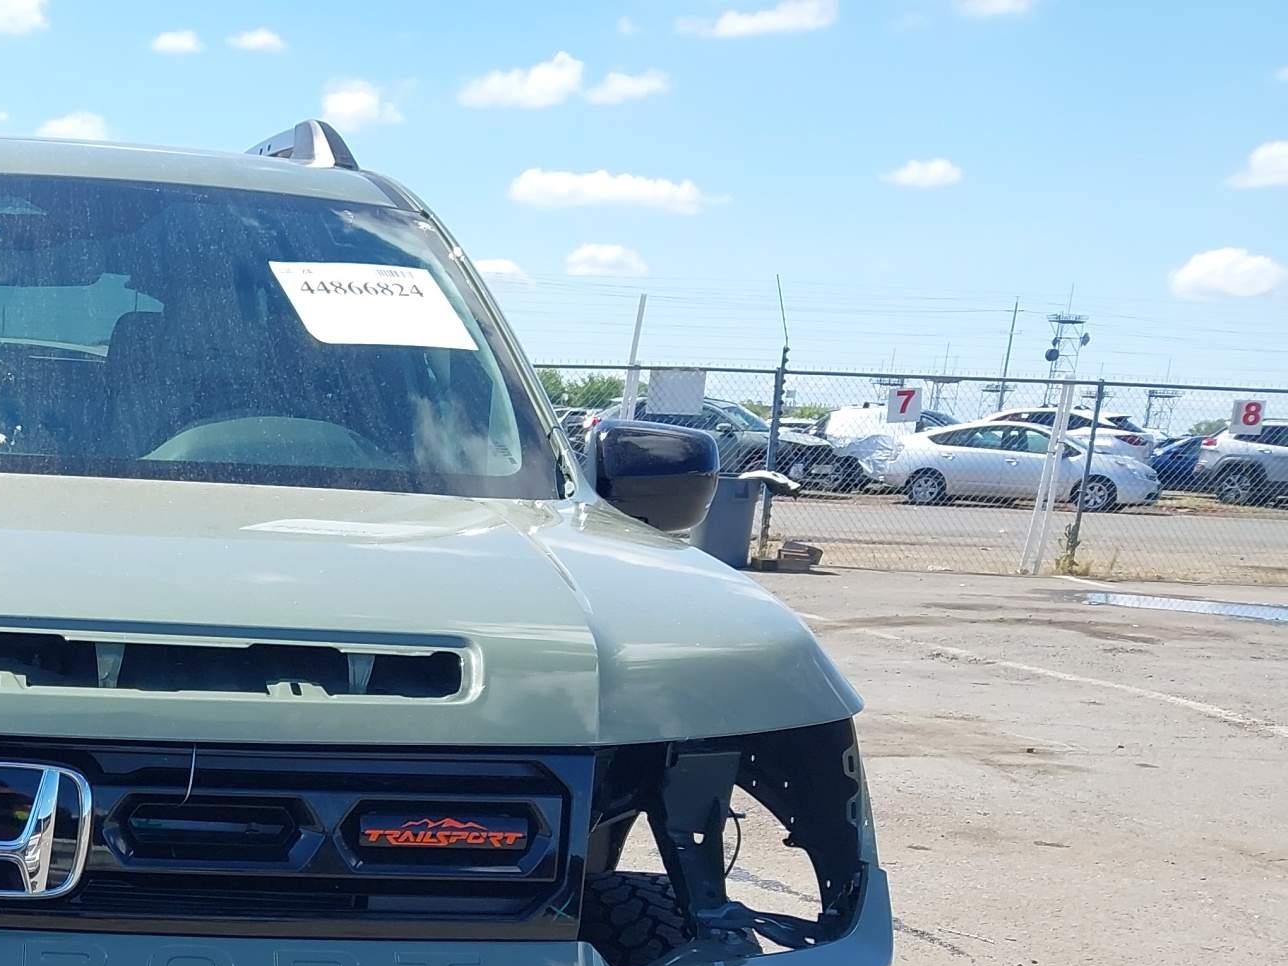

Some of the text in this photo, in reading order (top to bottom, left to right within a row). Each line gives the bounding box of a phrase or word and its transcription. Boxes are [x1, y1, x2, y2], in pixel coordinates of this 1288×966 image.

[300, 279, 425, 298] 44866824
[897, 390, 915, 413] 7
[1242, 402, 1262, 425] 8
[365, 830, 523, 847] TRAILSPORT
